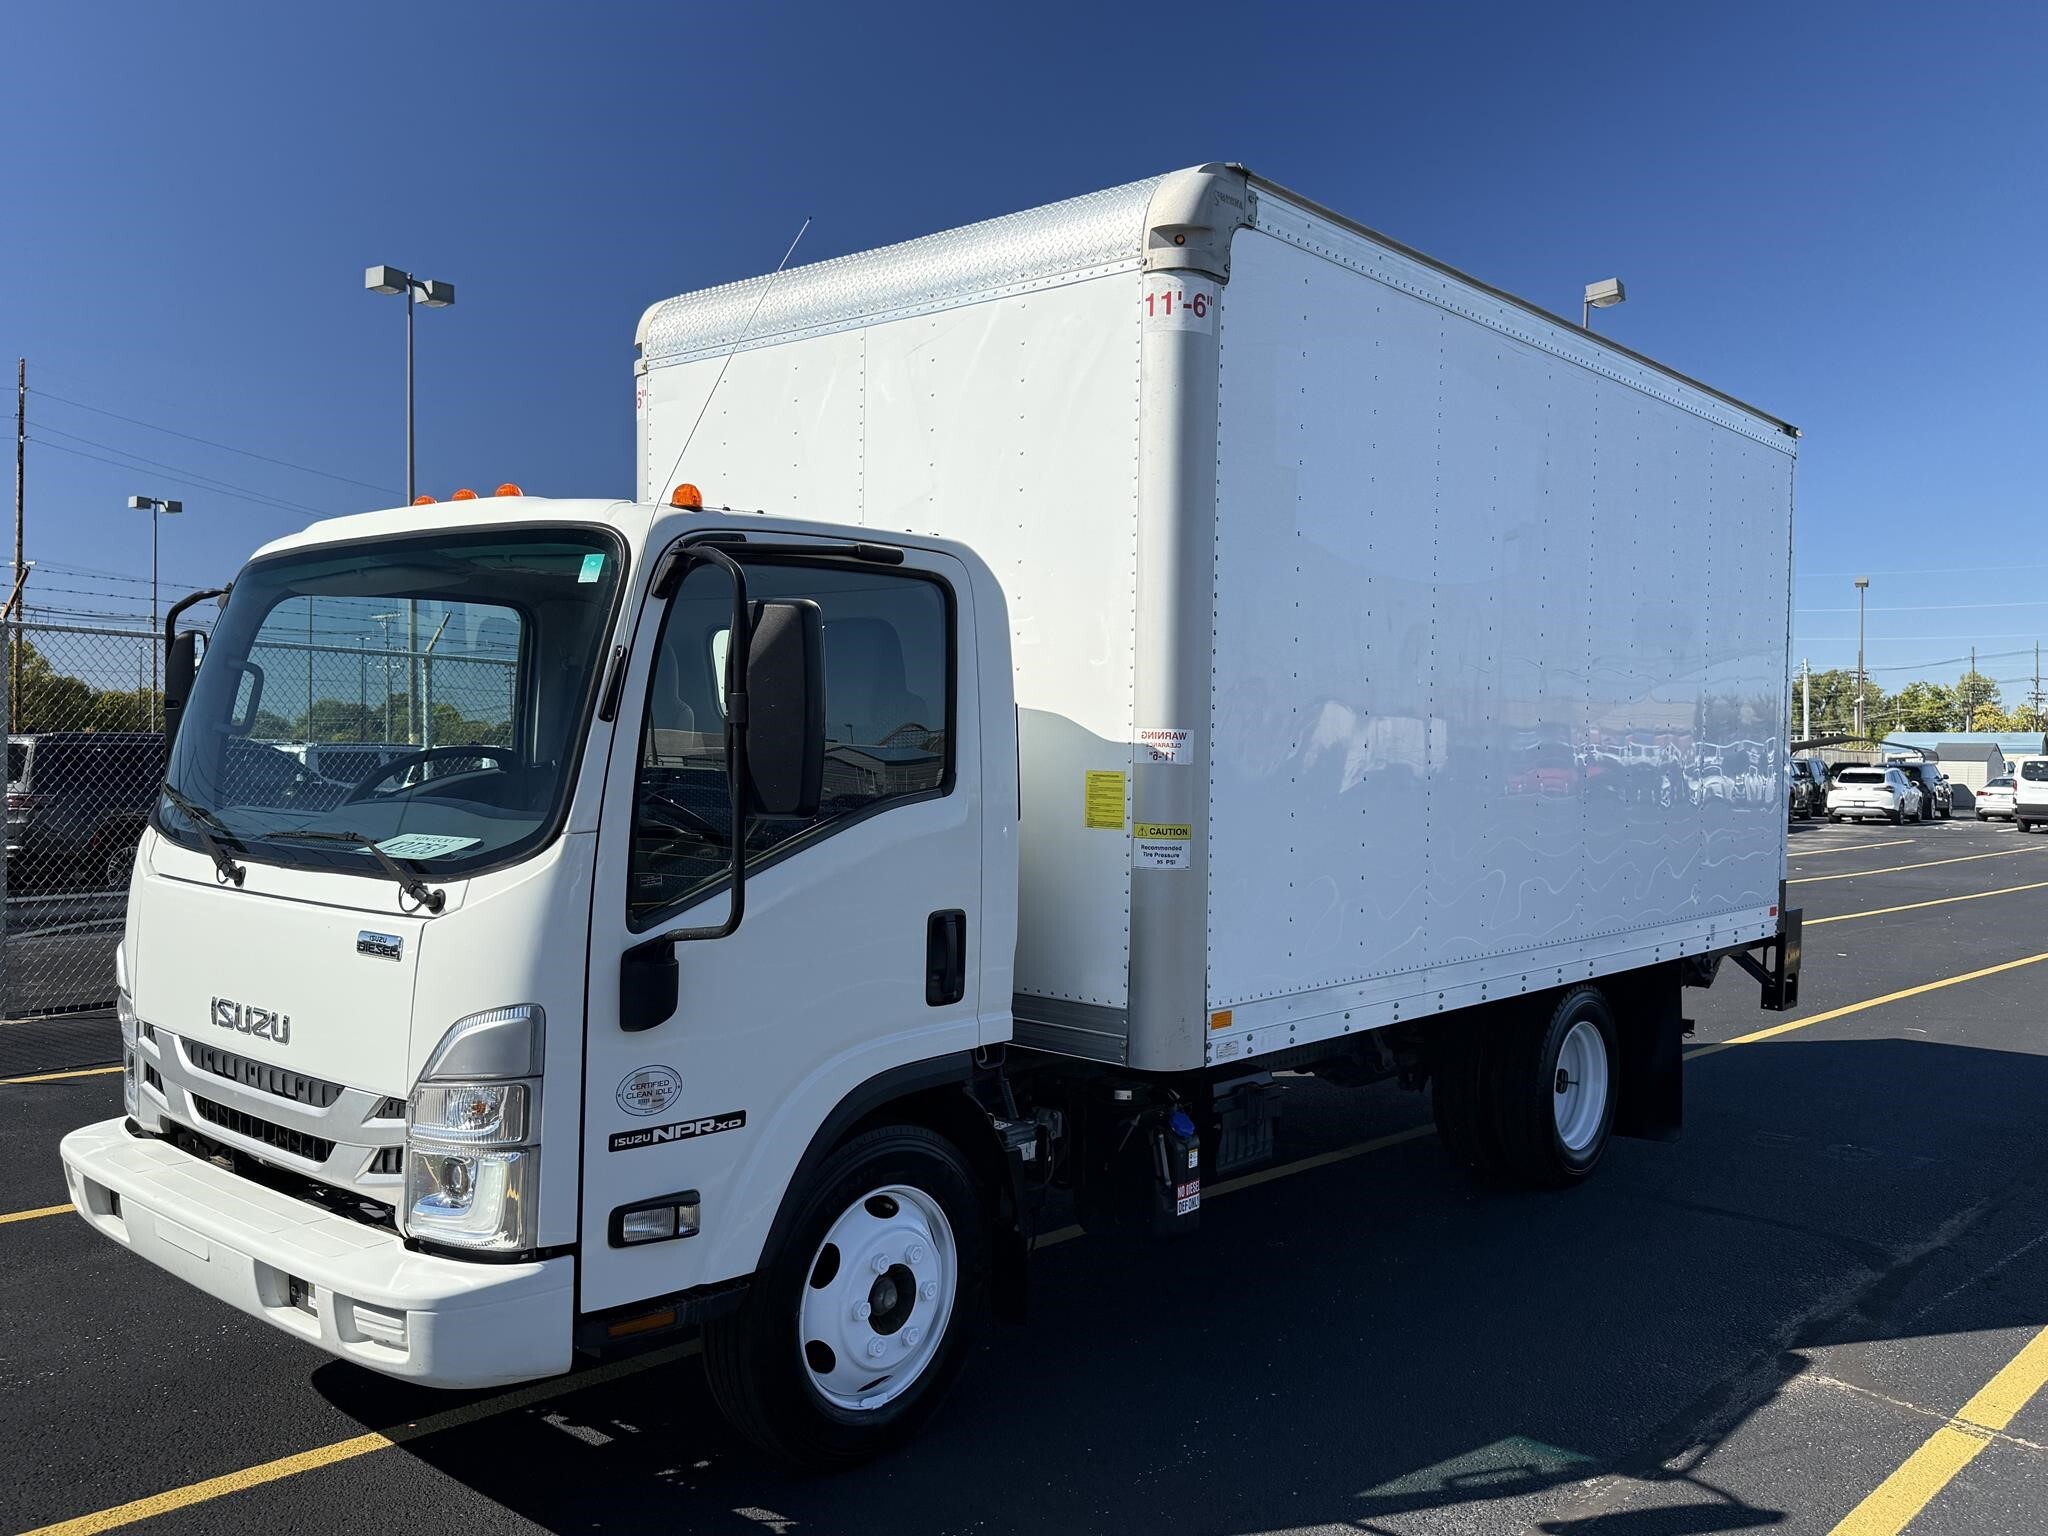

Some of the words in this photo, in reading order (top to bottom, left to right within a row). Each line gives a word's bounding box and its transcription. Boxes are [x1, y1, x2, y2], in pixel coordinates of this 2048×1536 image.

[1149, 827, 1188, 836] CAUTION
[369, 935, 387, 943] ISUZU
[357, 941, 399, 958] DIESEL
[210, 996, 291, 1046] ISUZU
[630, 1079, 670, 1091] CERTIFIED
[625, 1089, 653, 1100] CLEAN
[655, 1086, 673, 1096] IDLE
[614, 1133, 651, 1147] ISUZU
[1178, 1186, 1185, 1199] NO
[1178, 1199, 1188, 1213] DEF
